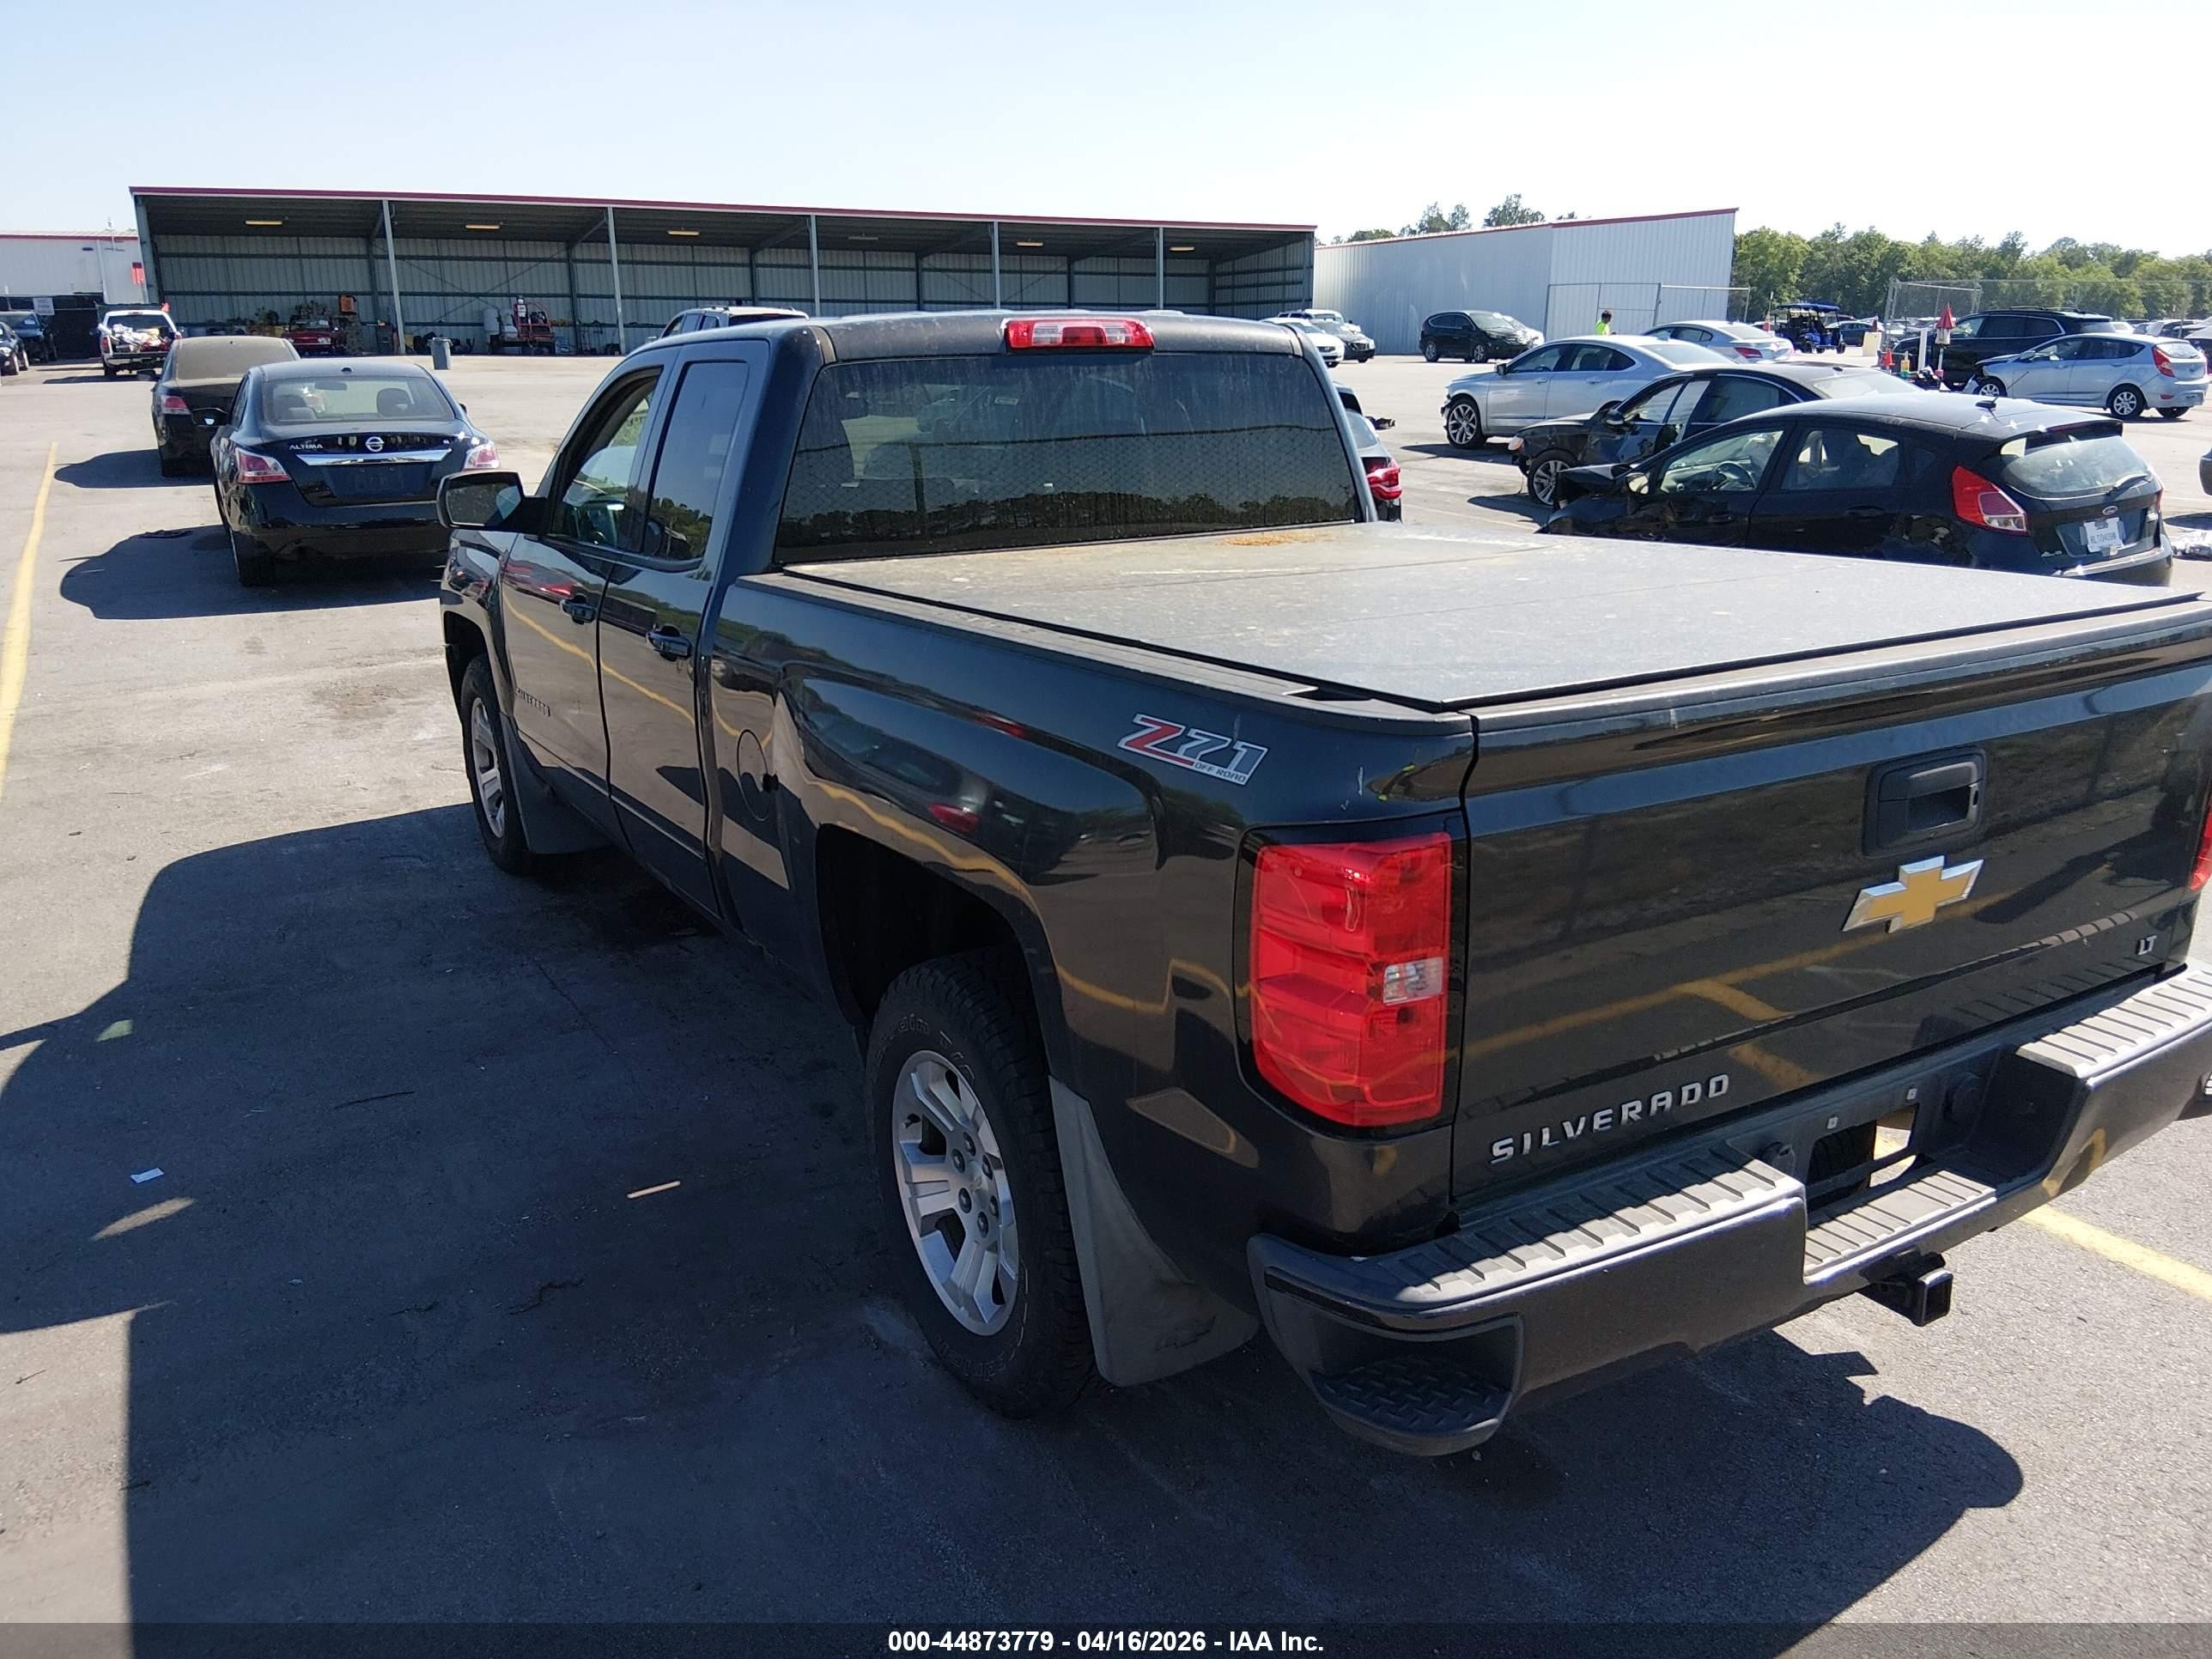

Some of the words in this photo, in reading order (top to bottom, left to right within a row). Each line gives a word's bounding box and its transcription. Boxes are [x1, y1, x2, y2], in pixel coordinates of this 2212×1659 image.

[1117, 714, 1269, 775] Z71
[1194, 760, 1213, 775] OFF
[1215, 767, 1248, 783] ROAD
[2137, 934, 2158, 956] LT
[1489, 1073, 1730, 1165] SILVERADO
